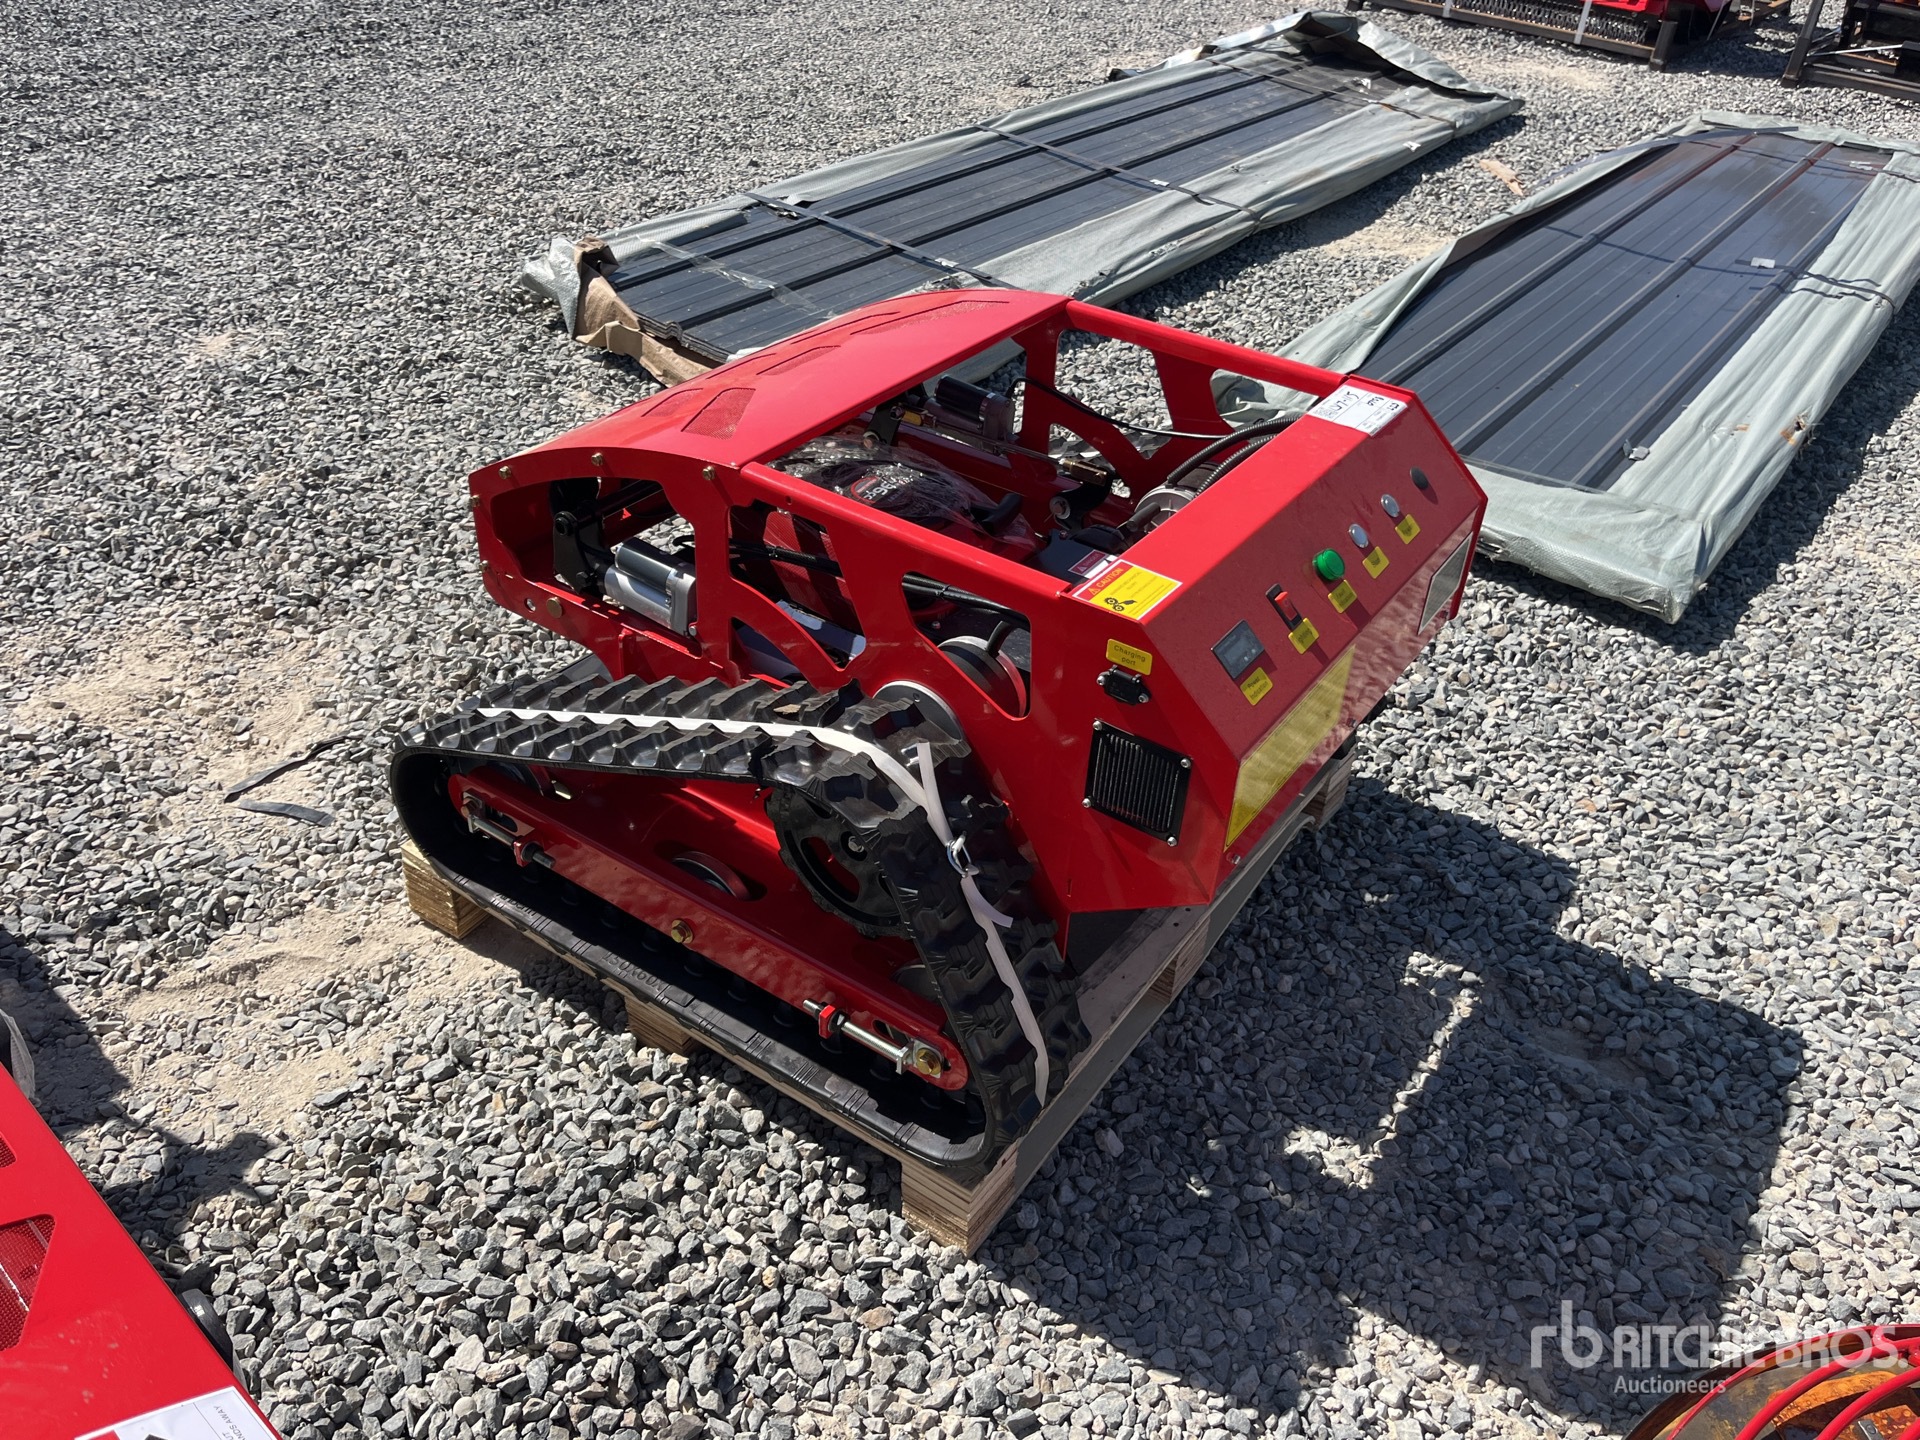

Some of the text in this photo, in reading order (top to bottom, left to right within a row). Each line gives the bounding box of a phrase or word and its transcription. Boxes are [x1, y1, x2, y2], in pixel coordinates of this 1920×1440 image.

[1096, 567, 1123, 587] CAUTION
[1114, 645, 1146, 662] Charging
[1121, 657, 1136, 666] port
[213, 1405, 233, 1425] AWAY
